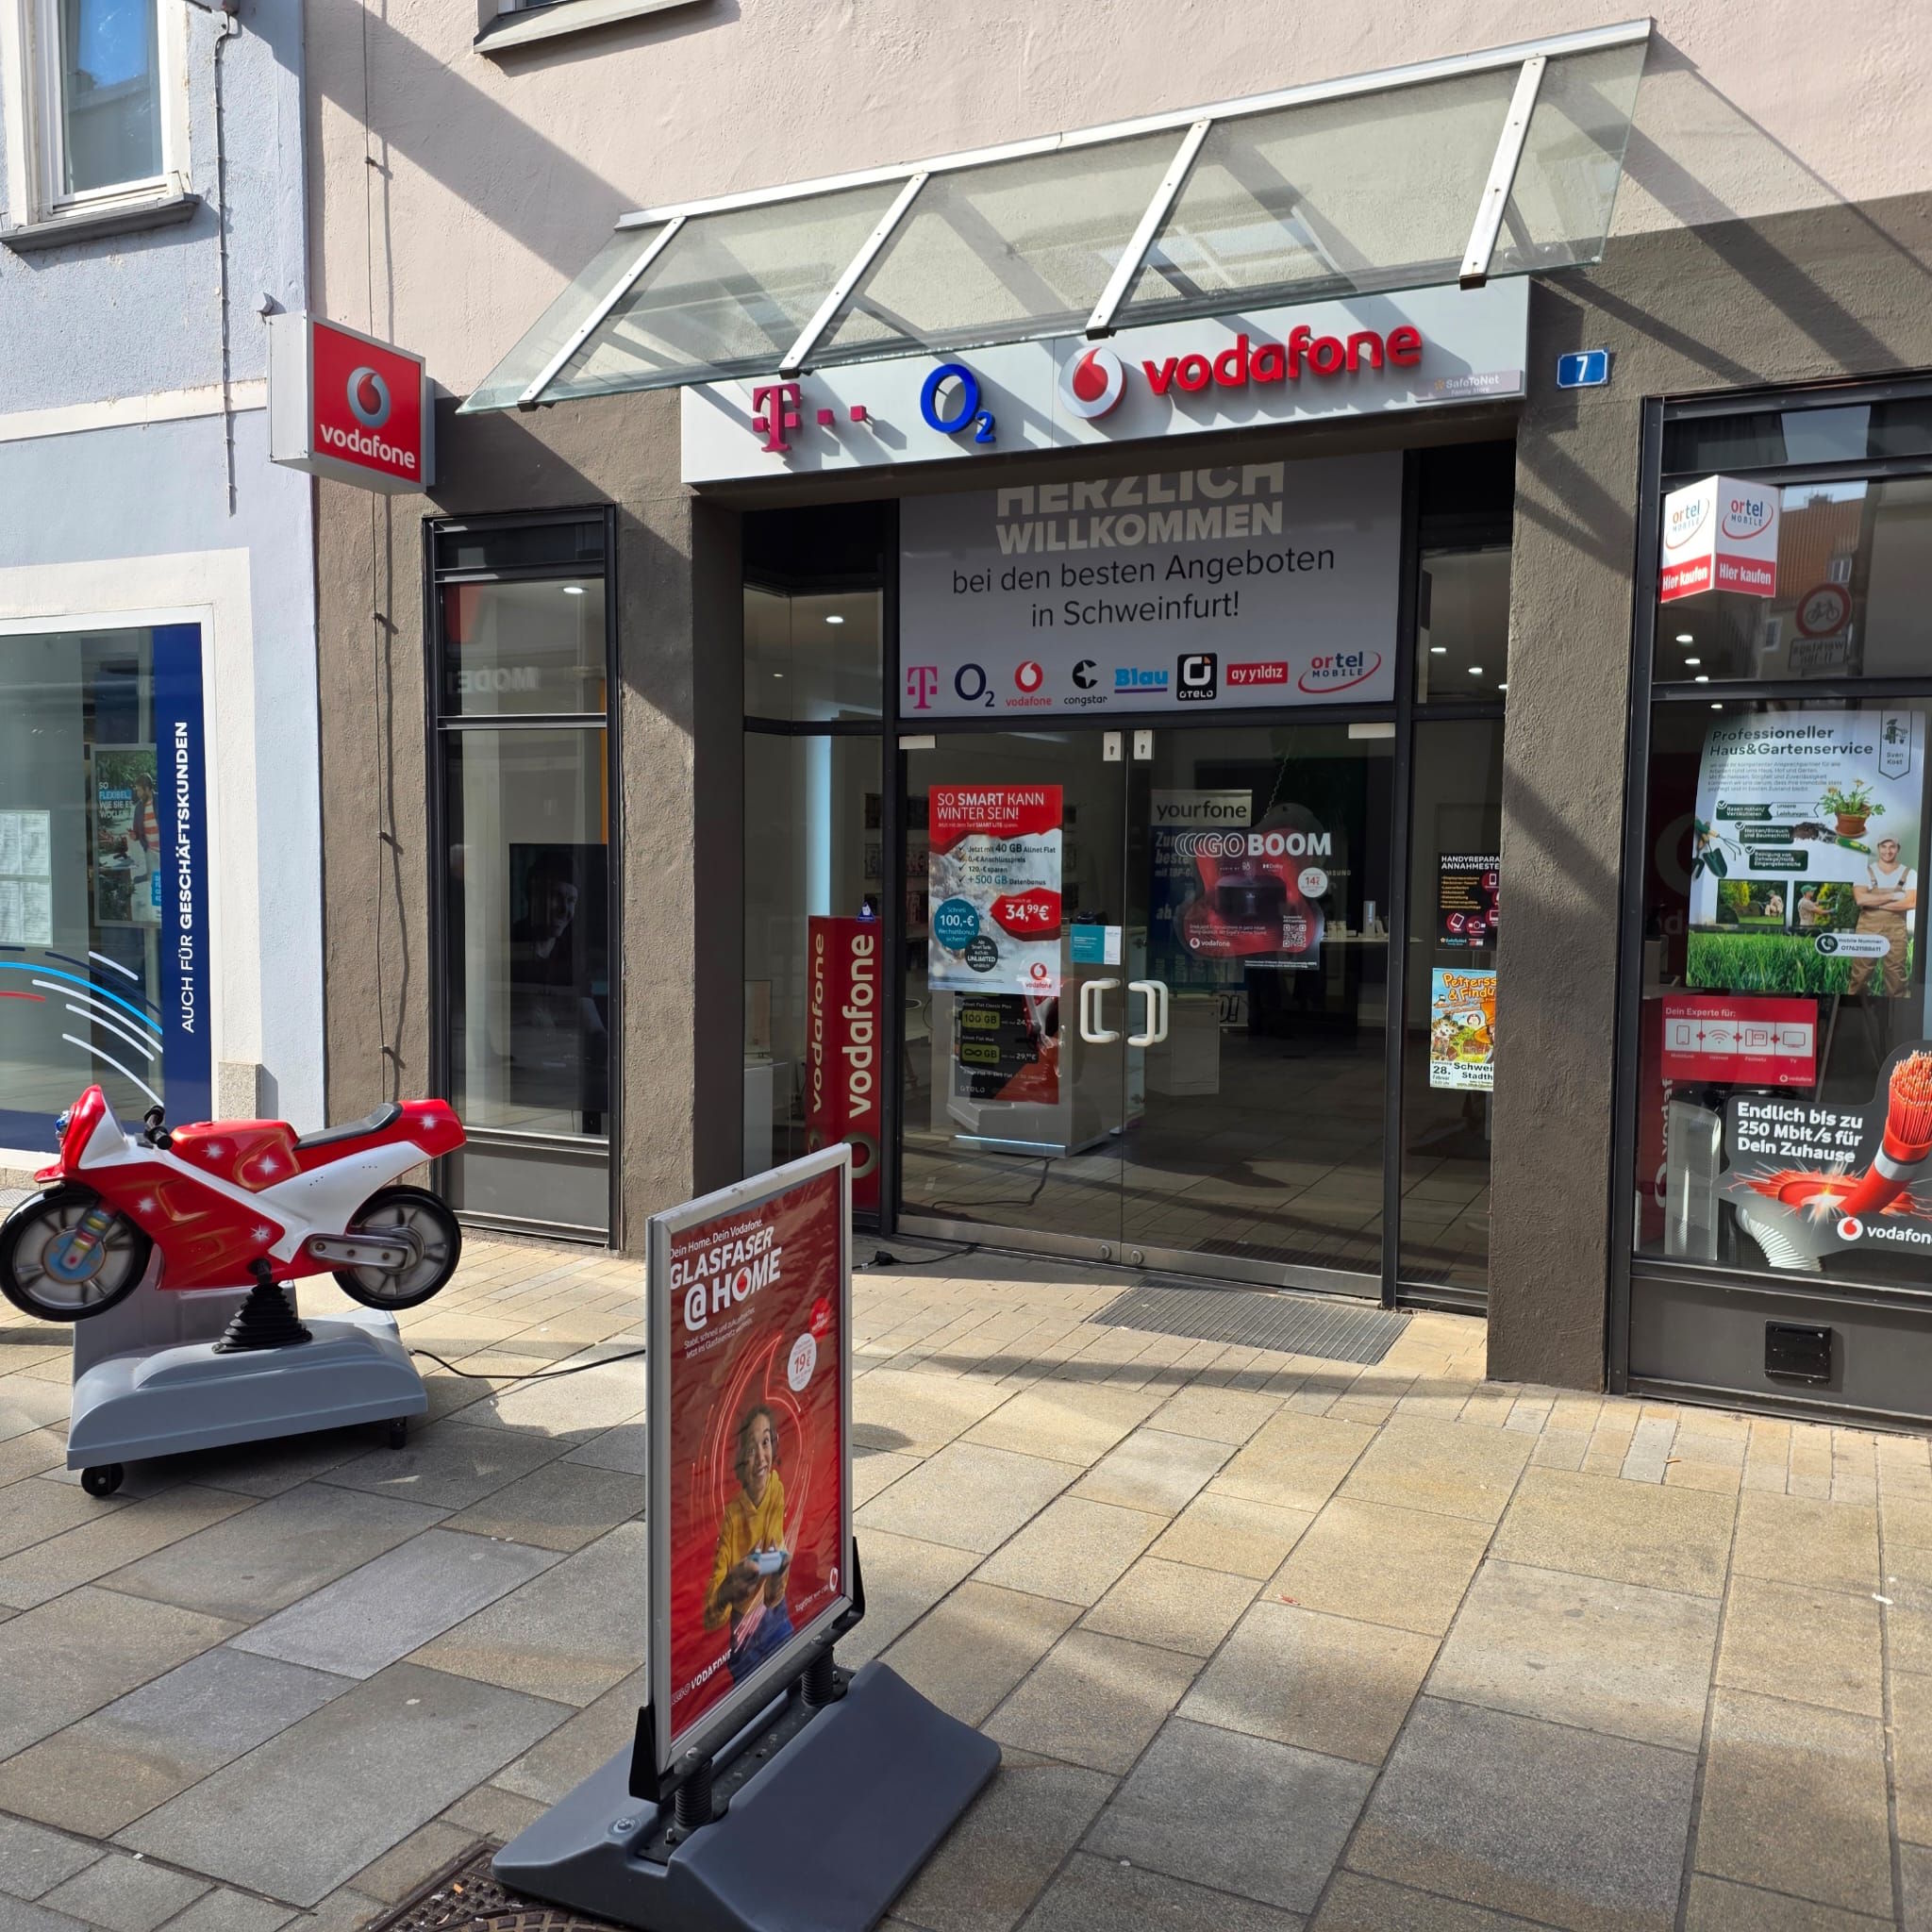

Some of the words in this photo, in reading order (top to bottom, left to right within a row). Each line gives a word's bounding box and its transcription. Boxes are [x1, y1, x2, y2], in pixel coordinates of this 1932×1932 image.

[1142, 325, 1422, 395] vodafone
[1576, 356, 1589, 382] 7
[320, 423, 416, 470] vodafone
[997, 461, 1285, 517] HERZLICH
[1673, 503, 1700, 523] ortel
[1730, 499, 1763, 517] ortel
[996, 500, 1284, 555] WILLKOMMEN
[1731, 515, 1762, 526] MOBILE
[953, 569, 991, 593] bei
[1001, 565, 1050, 591] den
[1060, 560, 1155, 588] besten
[1165, 547, 1335, 584] Angeboten
[1662, 575, 1678, 591] Hier
[1680, 566, 1707, 586] kaufen
[1719, 563, 1738, 580] Hier
[1740, 567, 1771, 585] kaufen
[1031, 604, 1053, 627] in
[1064, 591, 1239, 625] Schweinfurt!
[1311, 652, 1363, 670] ortel
[1114, 667, 1168, 687] Blau
[1231, 671, 1246, 682] ay
[1312, 668, 1362, 678] MOBILE
[1006, 696, 1052, 708] vodafone
[1063, 695, 1108, 707] congstar
[1712, 725, 1834, 741] Professioneller
[1709, 741, 1874, 757] Haus&Gartenservice
[937, 792, 955, 806] SO
[958, 792, 1004, 806] SMART
[1008, 791, 1044, 806] KANN
[937, 807, 984, 820] WINTER
[988, 807, 1019, 820] SEIN!
[1157, 800, 1246, 821] yourfone
[175, 722, 192, 930] GESCHÄFTSKUNDEN
[995, 843, 1008, 853] 40
[1009, 843, 1023, 853] GB
[974, 875, 992, 884] 500
[994, 875, 1008, 884] GB
[1157, 903, 1173, 920] ab
[179, 935, 193, 971] FÜR
[182, 975, 194, 1033] AUCH
[1686, 1008, 1719, 1017] Experte
[1721, 1008, 1736, 1017] für:
[811, 933, 824, 1113] vodafone
[841, 934, 874, 1118] vodafone
[965, 1014, 981, 1024] 100
[984, 1015, 997, 1024] GB
[984, 1050, 997, 1058] GB
[1433, 1066, 1451, 1074] 28.
[1738, 1102, 1806, 1123] Endlich
[1809, 1108, 1837, 1126] bis
[1840, 1116, 1863, 1129] zu
[1738, 1121, 1770, 1137] 250
[1774, 1123, 1832, 1143] Mbit/s
[1834, 1129, 1863, 1147] für
[1738, 1137, 1776, 1155] Dein
[1779, 1141, 1856, 1163] Zuhause
[688, 1237, 712, 1253] Home.
[712, 1230, 730, 1243] Dein
[730, 1219, 762, 1238] Vodafone.
[1867, 1225, 1932, 1245] vodafon
[670, 1226, 774, 1291] GLASFASER
